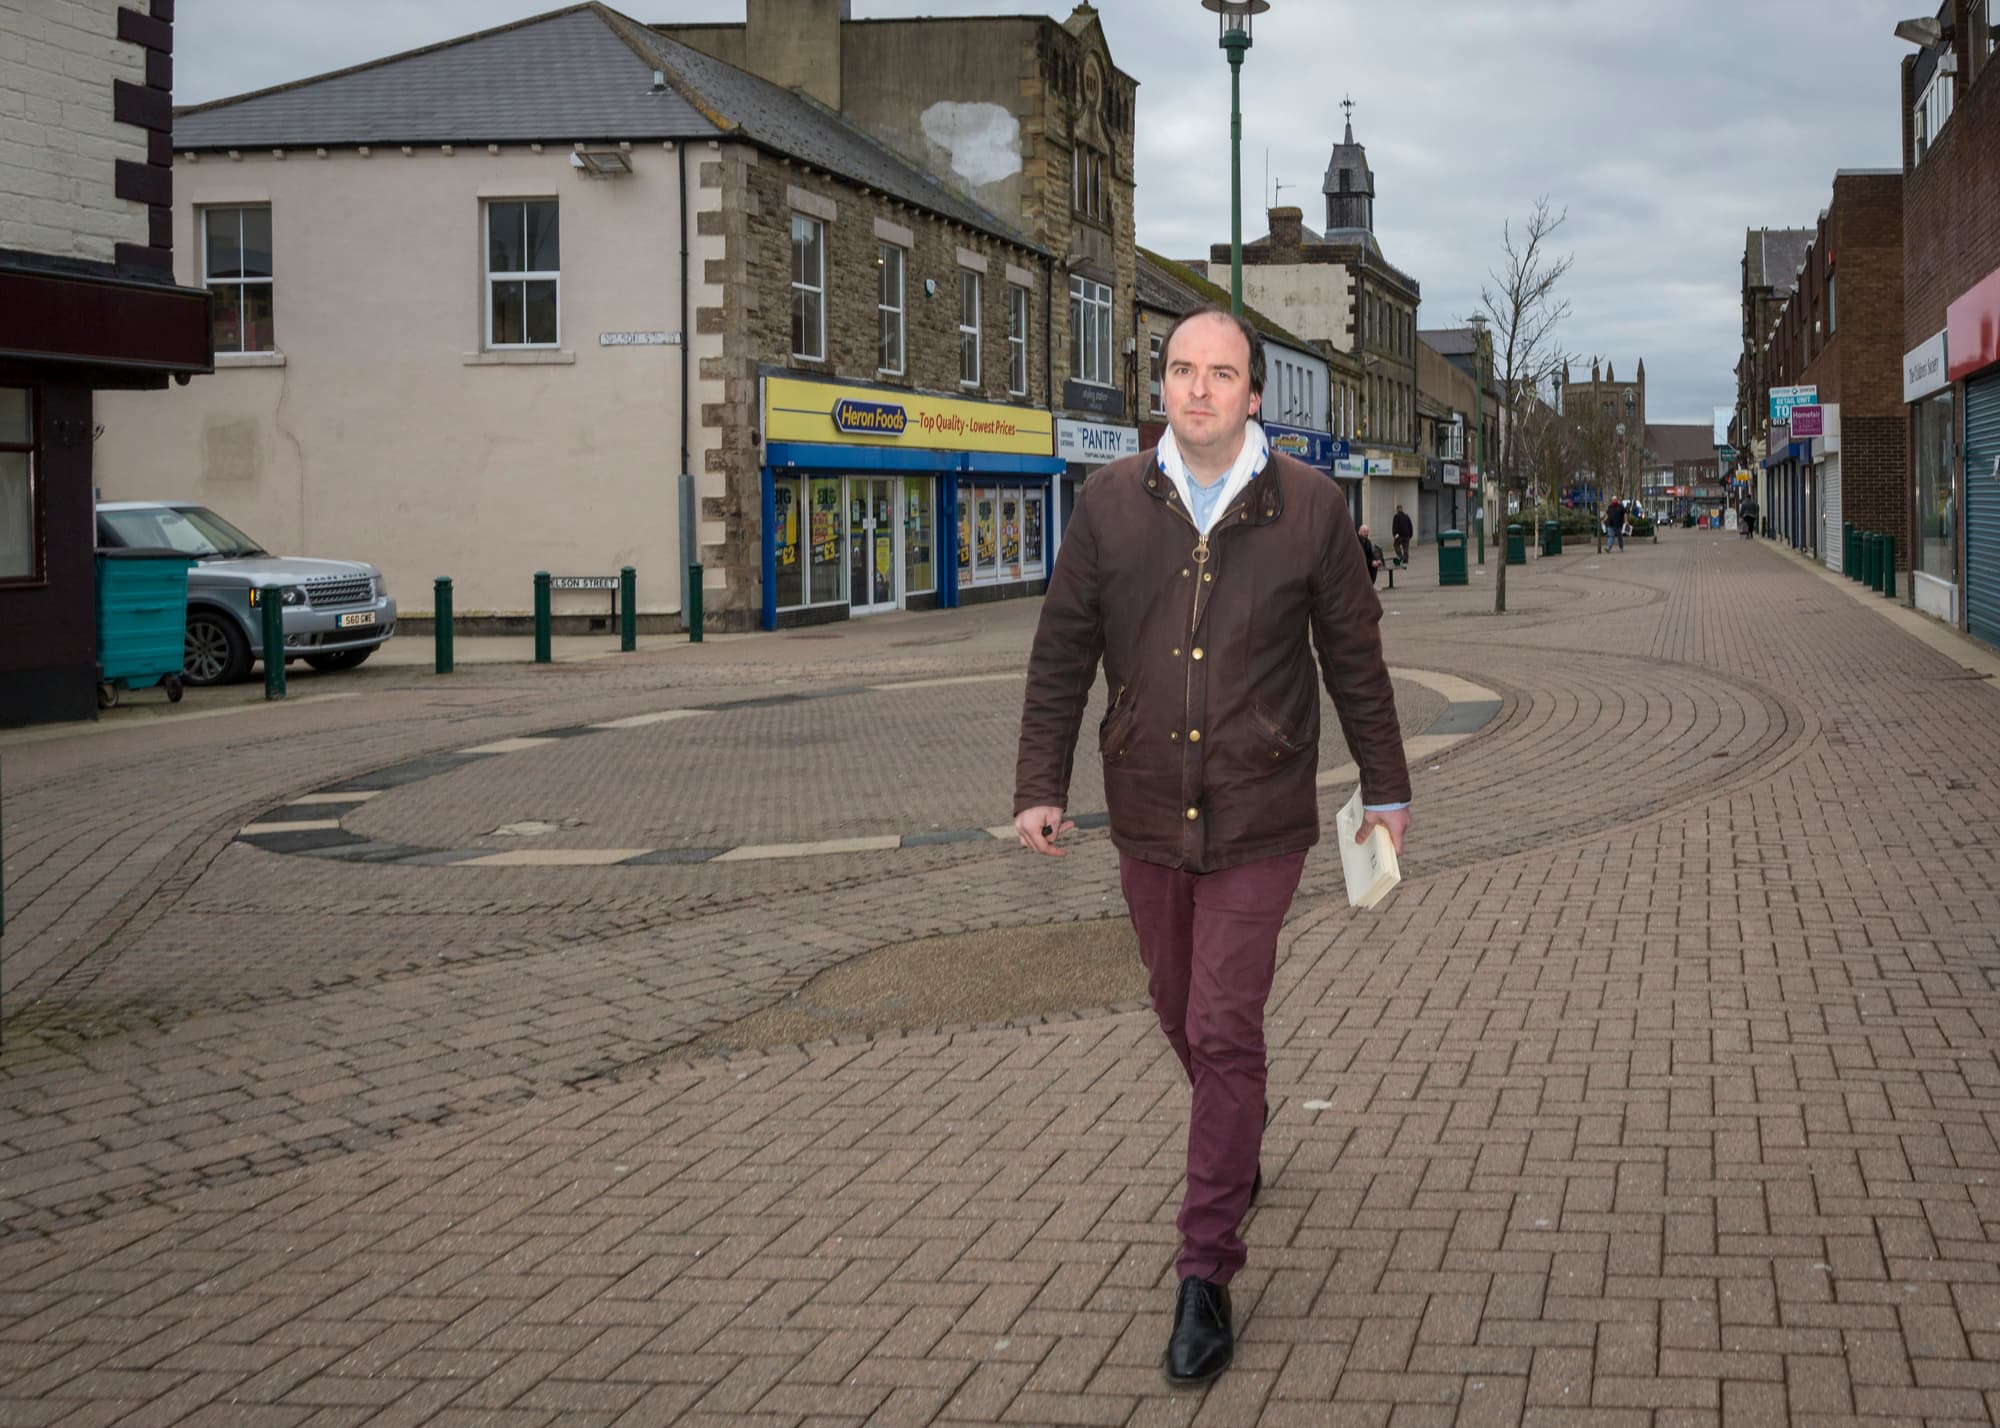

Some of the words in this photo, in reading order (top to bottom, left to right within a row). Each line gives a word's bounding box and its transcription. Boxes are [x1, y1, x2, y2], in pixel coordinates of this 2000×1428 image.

[841, 405, 875, 428] Heron
[875, 407, 904, 430] Foods
[1775, 405, 1790, 417] TO
[919, 412, 934, 434] Top
[936, 415, 965, 436] Quality
[970, 418, 995, 434] Lowest
[996, 420, 1016, 436] Prices
[1082, 427, 1122, 452] PANTRY
[550, 579, 580, 588] ELSON
[583, 579, 615, 588] STREET
